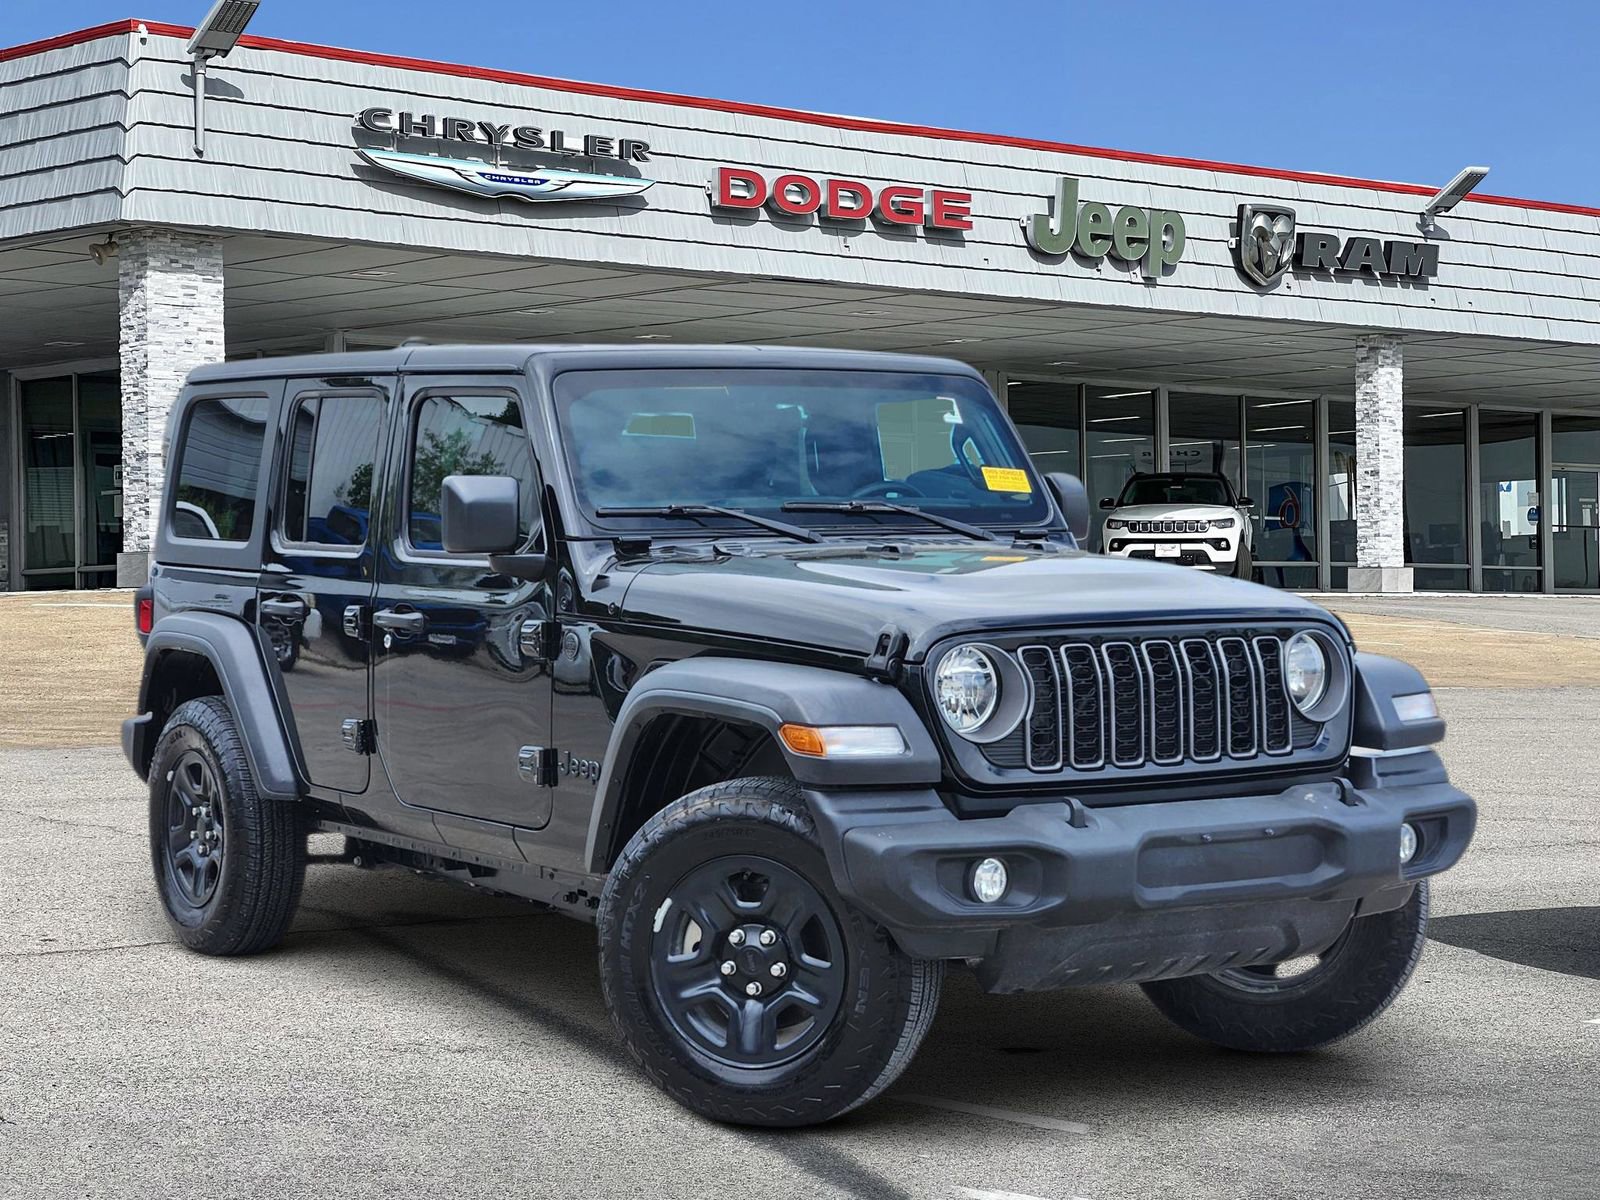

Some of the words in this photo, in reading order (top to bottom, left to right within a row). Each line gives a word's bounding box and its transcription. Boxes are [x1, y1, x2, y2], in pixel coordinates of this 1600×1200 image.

[358, 107, 651, 162] CHRYSLER
[484, 174, 541, 185] CHRYSLER
[711, 166, 973, 231] DODGE
[1028, 177, 1186, 277] Jeep
[1295, 232, 1439, 277] RAM
[558, 751, 600, 785] Jeep
